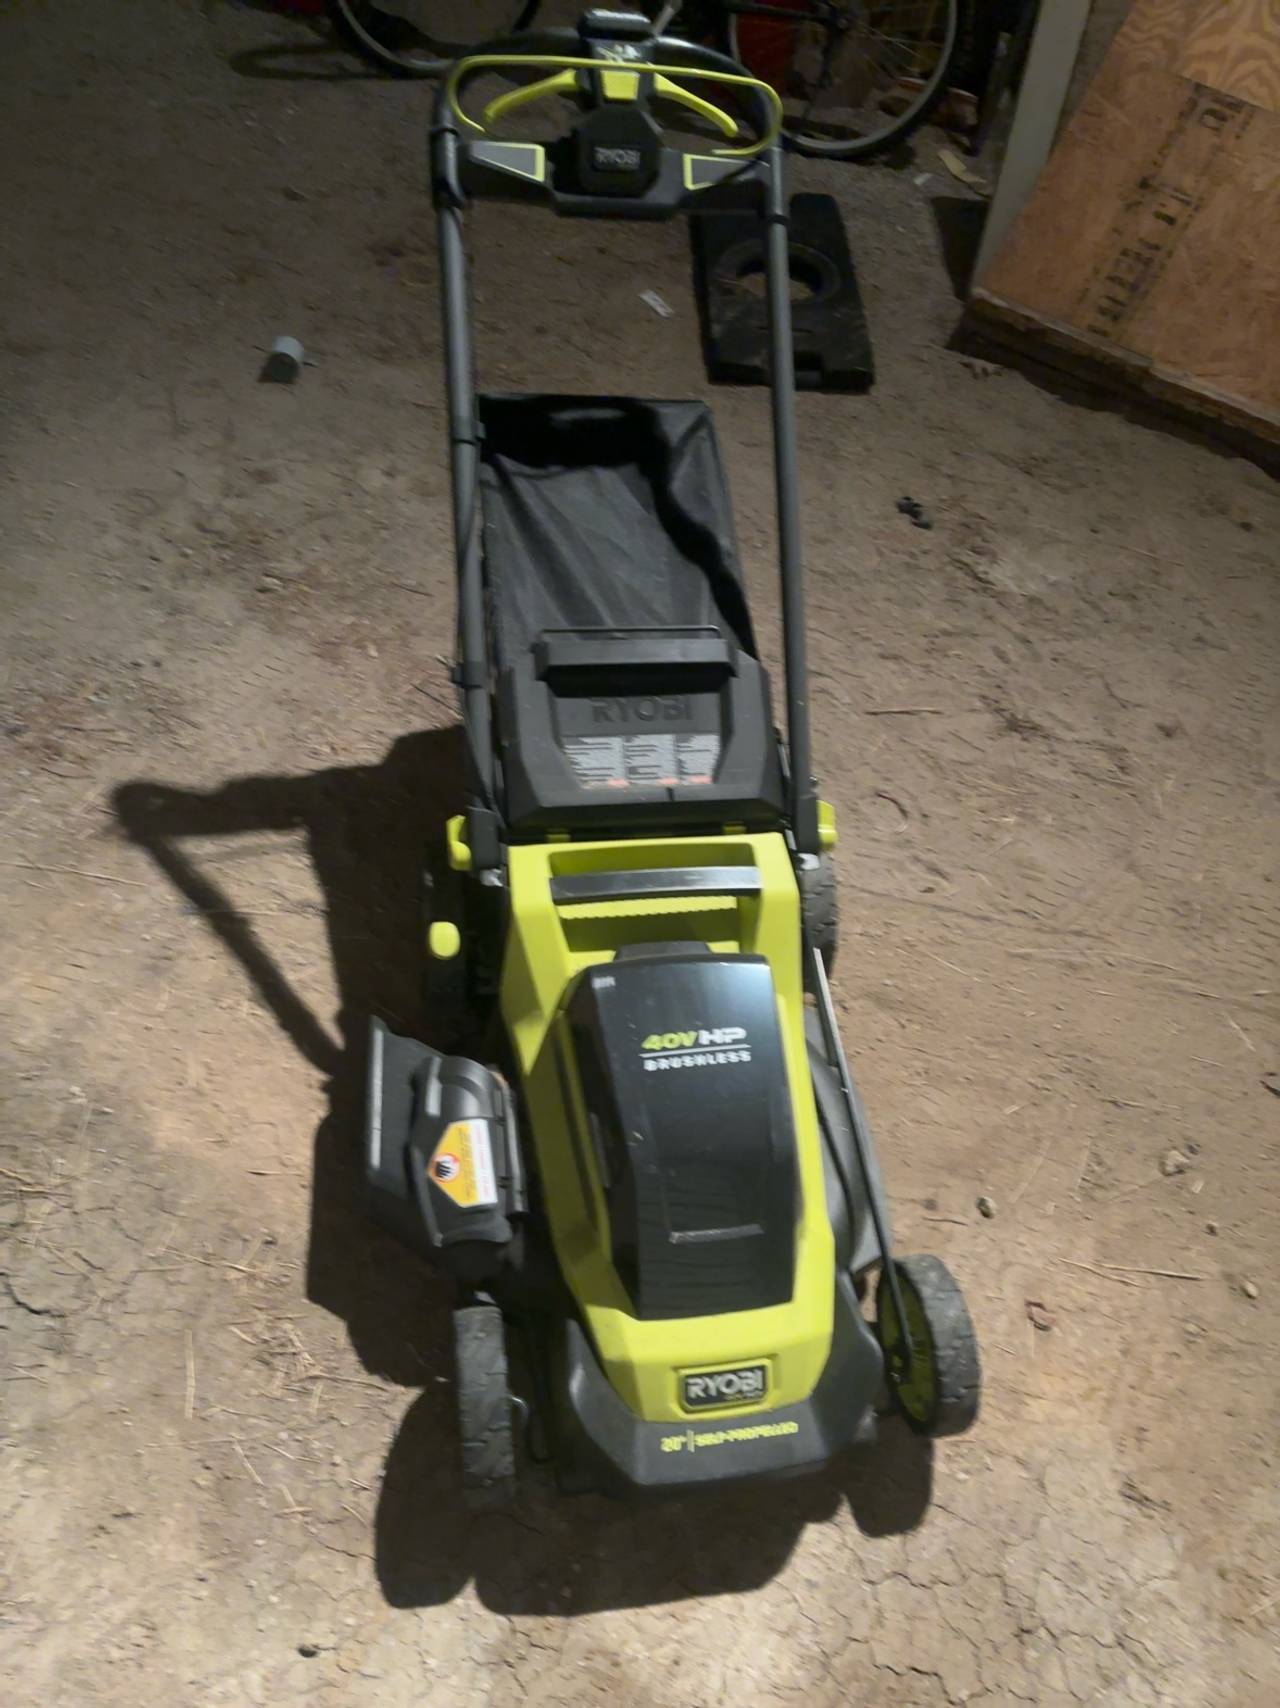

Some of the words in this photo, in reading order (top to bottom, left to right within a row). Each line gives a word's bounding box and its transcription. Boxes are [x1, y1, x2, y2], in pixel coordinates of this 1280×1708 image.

[591, 696, 694, 723] RYOBI
[641, 1030, 698, 1050] 40V
[698, 1026, 747, 1045] HP
[643, 1050, 752, 1072] BRUSHLESS
[687, 1369, 763, 1399] RYOBI
